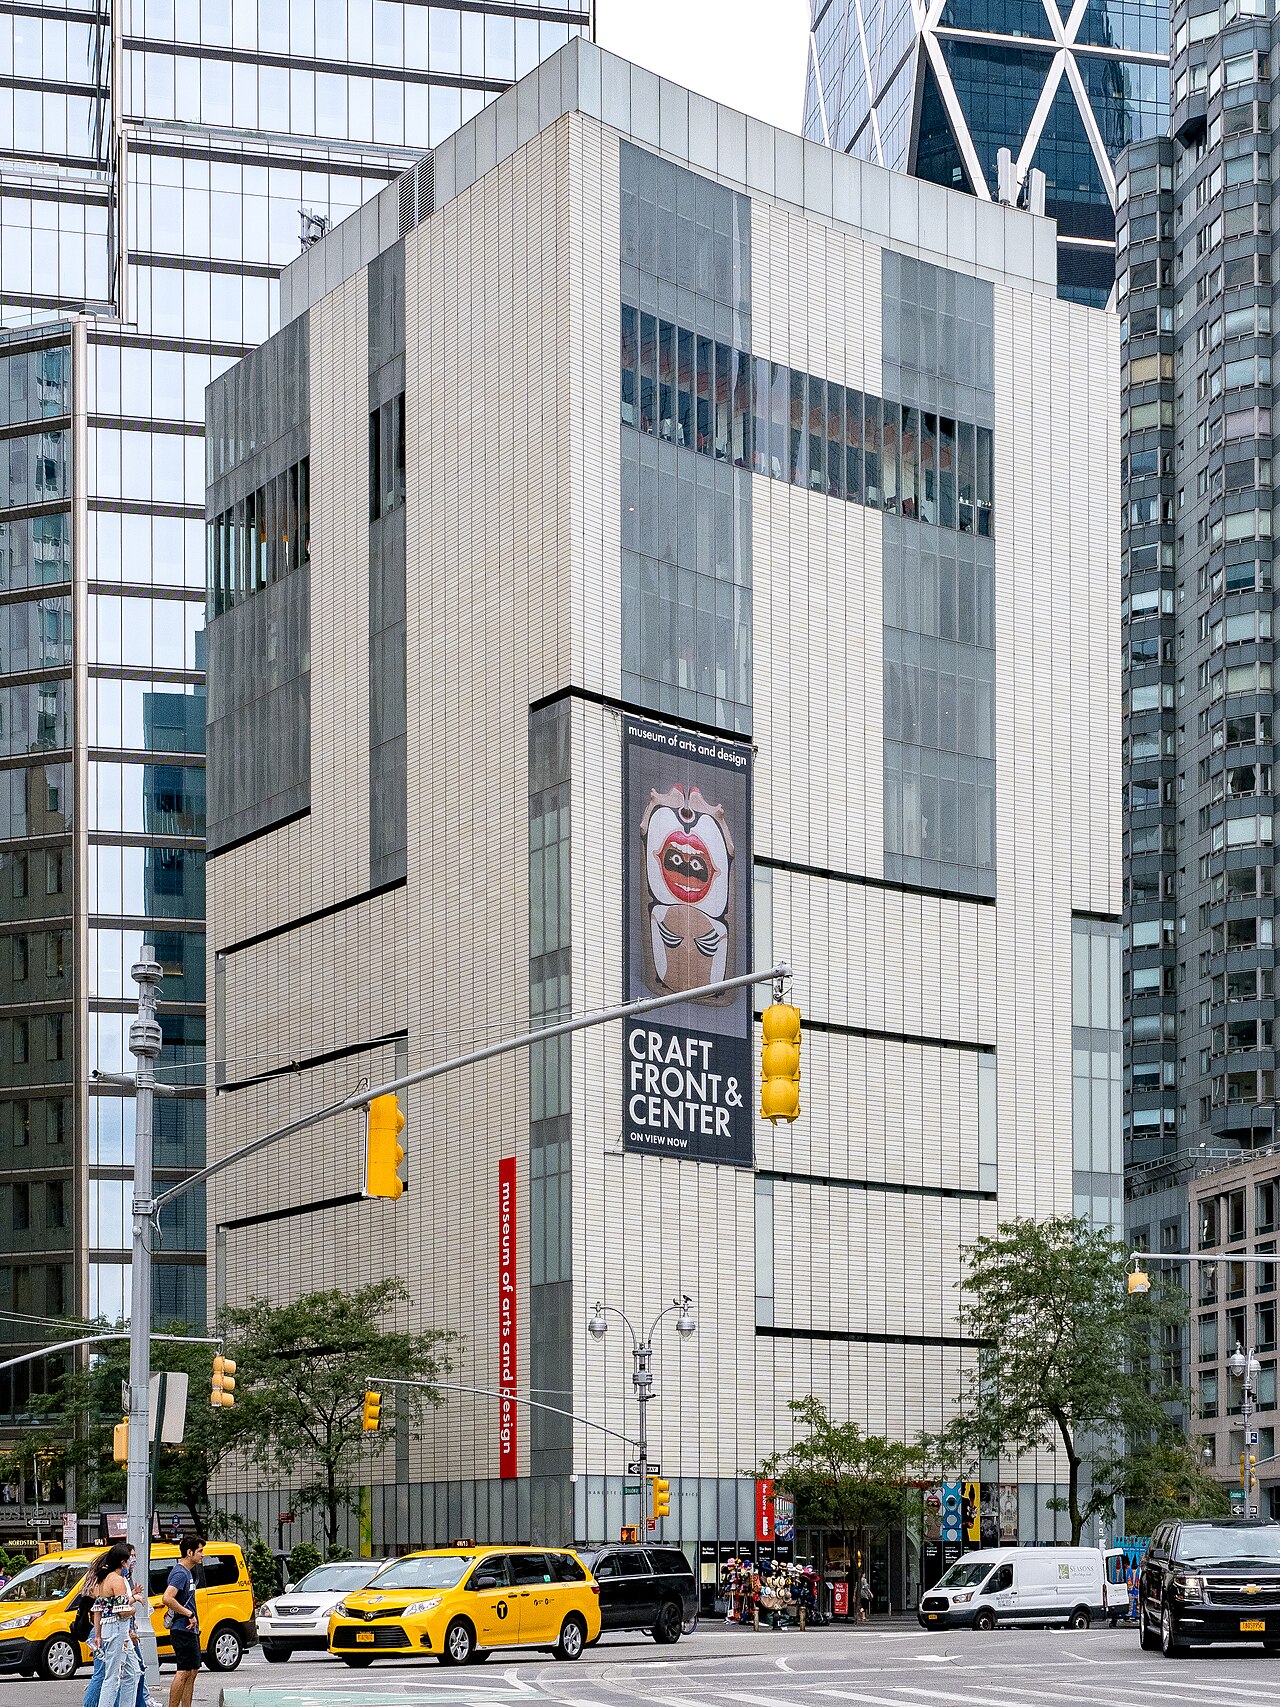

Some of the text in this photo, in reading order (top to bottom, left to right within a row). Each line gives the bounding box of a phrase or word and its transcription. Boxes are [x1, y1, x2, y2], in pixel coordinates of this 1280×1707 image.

[628, 726, 746, 766] museum of arts and design
[629, 1028, 713, 1070] CRAFT
[631, 1061, 743, 1108] FRONT &
[629, 1094, 731, 1137] CENTER
[630, 1132, 688, 1148] ON VIEW NOW
[500, 1182, 513, 1454] museum of arts and design
